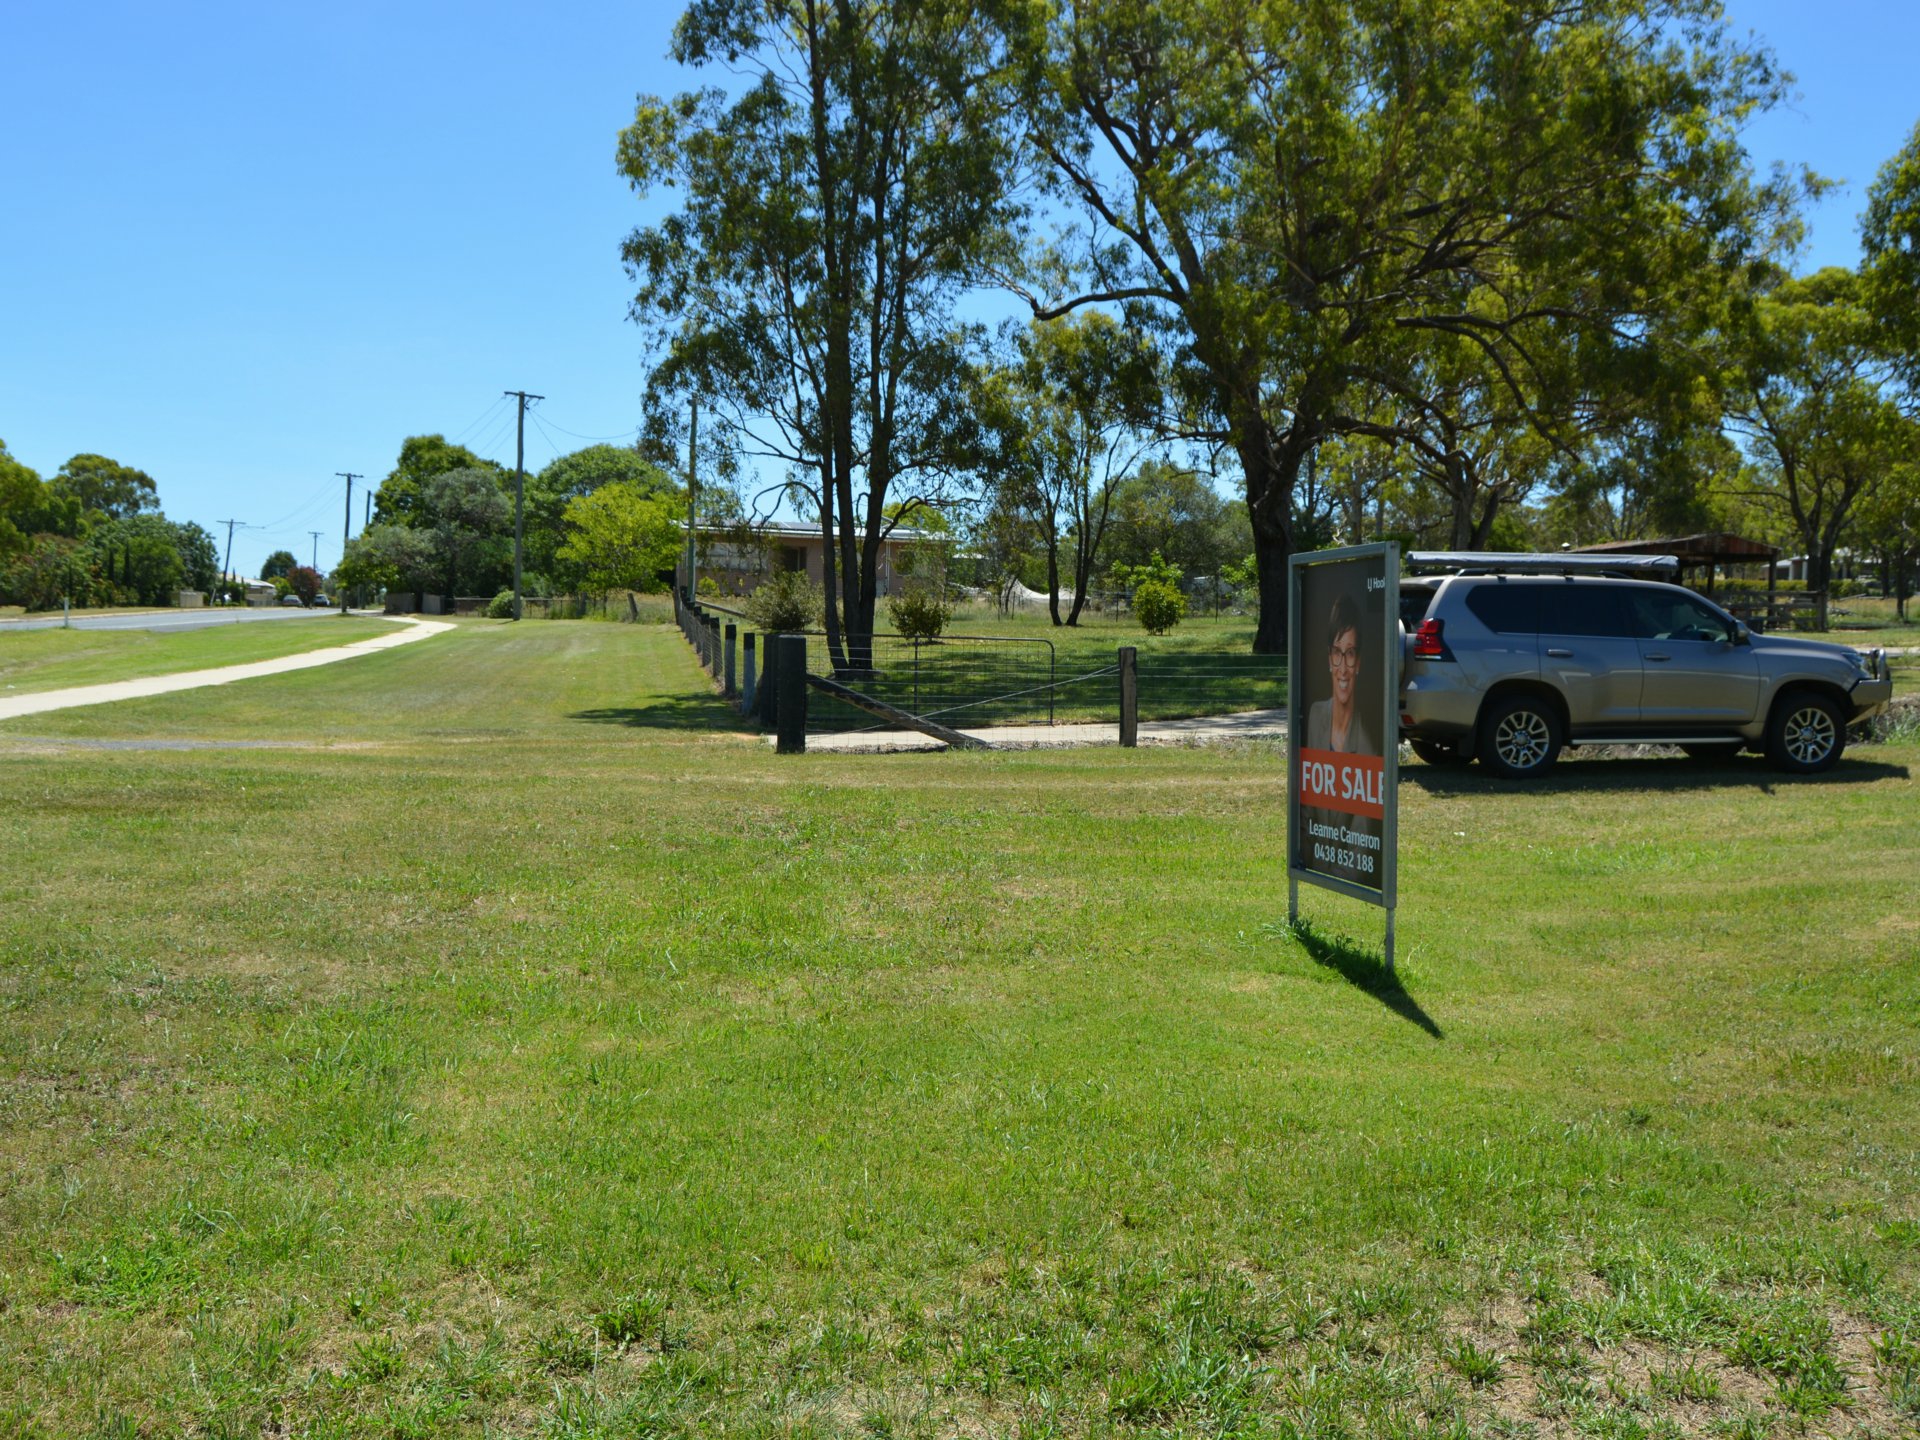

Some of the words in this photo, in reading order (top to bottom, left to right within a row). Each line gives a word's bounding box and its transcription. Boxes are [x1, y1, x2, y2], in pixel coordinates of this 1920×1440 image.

[1302, 760, 1336, 797] FOR
[1309, 818, 1339, 841] Leanne
[1340, 826, 1380, 851] Cameron
[1314, 842, 1336, 863] 0438
[1337, 848, 1354, 868] 852
[1356, 852, 1374, 873] 188
